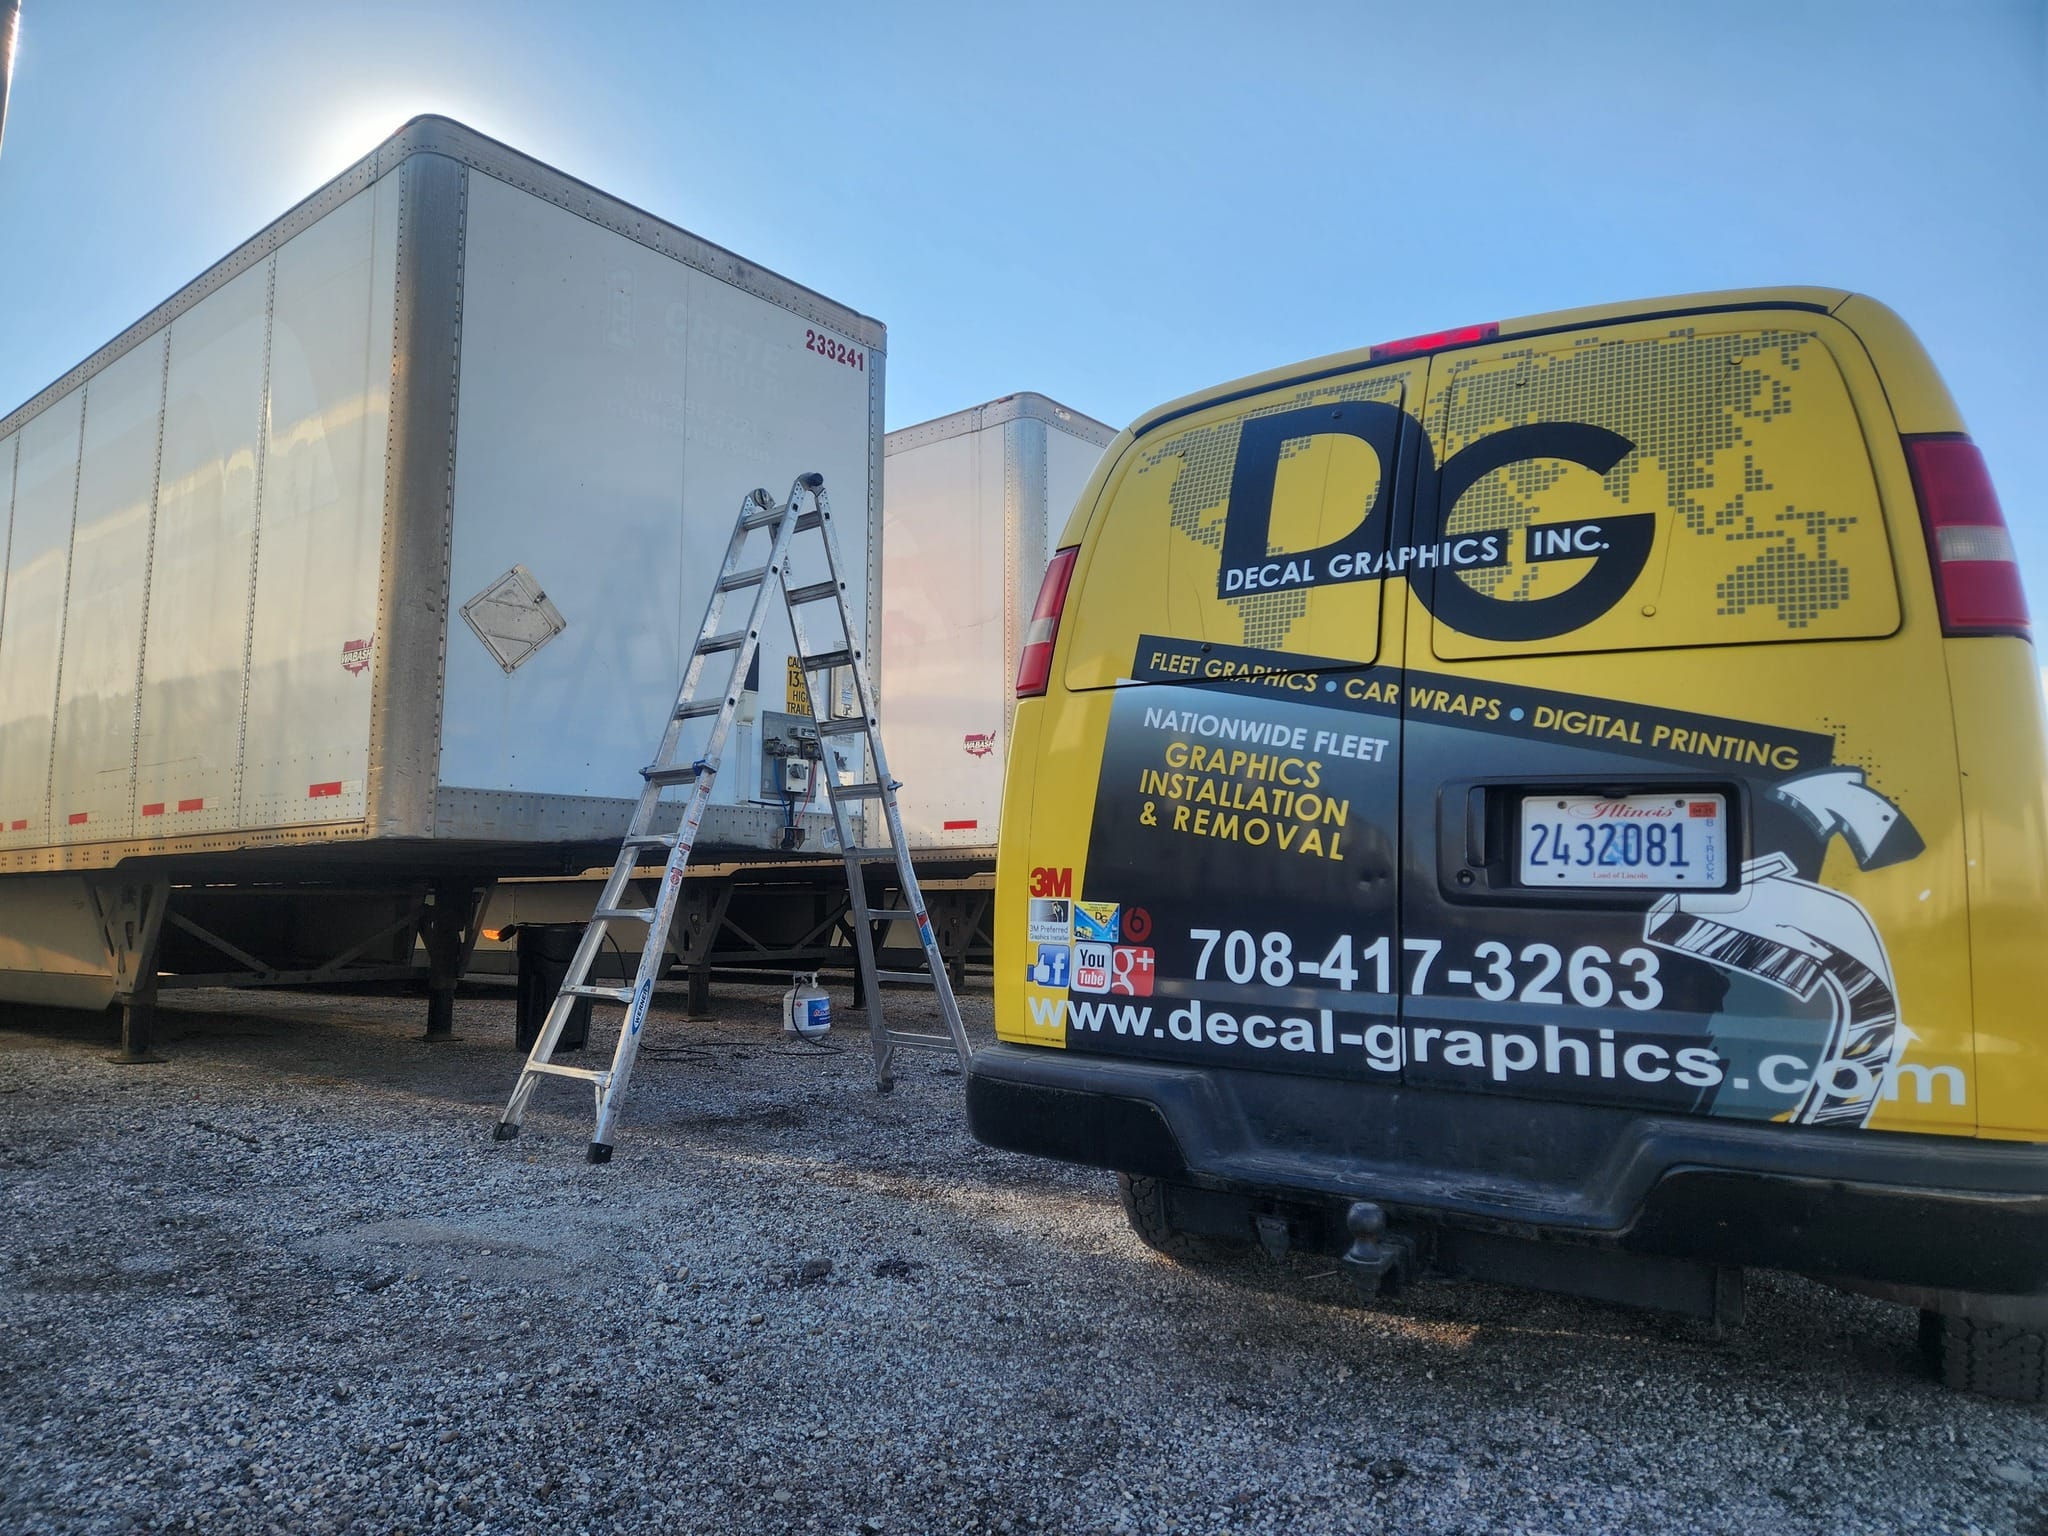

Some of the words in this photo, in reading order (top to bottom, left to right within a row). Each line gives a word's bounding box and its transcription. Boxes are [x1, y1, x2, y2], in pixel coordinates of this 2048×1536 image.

[806, 328, 864, 372] 233241
[1225, 558, 1315, 591] DECAL
[1328, 536, 1500, 579] GRAPHICS
[1533, 524, 1610, 556] INC.
[340, 648, 372, 664] WABASH
[787, 702, 814, 716] TRAILE
[1149, 652, 1201, 675] FLEET
[1204, 658, 1320, 693] GRAPHICS
[1344, 678, 1400, 705] CAR
[1409, 686, 1502, 722] WRAPS
[1533, 706, 1643, 745] DIGITAL
[1651, 724, 1800, 771] PRINTING
[1143, 707, 1308, 750] NATIONWIDE
[1313, 730, 1390, 763] FLEET
[1165, 742, 1323, 789] GRAPHICS
[1138, 768, 1350, 828] INSTALLATION
[1568, 800, 1676, 819] Illinois
[1139, 801, 1158, 827] &
[1173, 805, 1345, 861] REMOVAL
[1530, 822, 1690, 867] 2432081
[1029, 867, 1072, 898] 3M
[1079, 970, 1105, 986] Tube
[1080, 949, 1105, 967] You
[1190, 928, 1664, 1011] 708-417-3263
[1028, 996, 1967, 1106] www.decal-graphics.com
